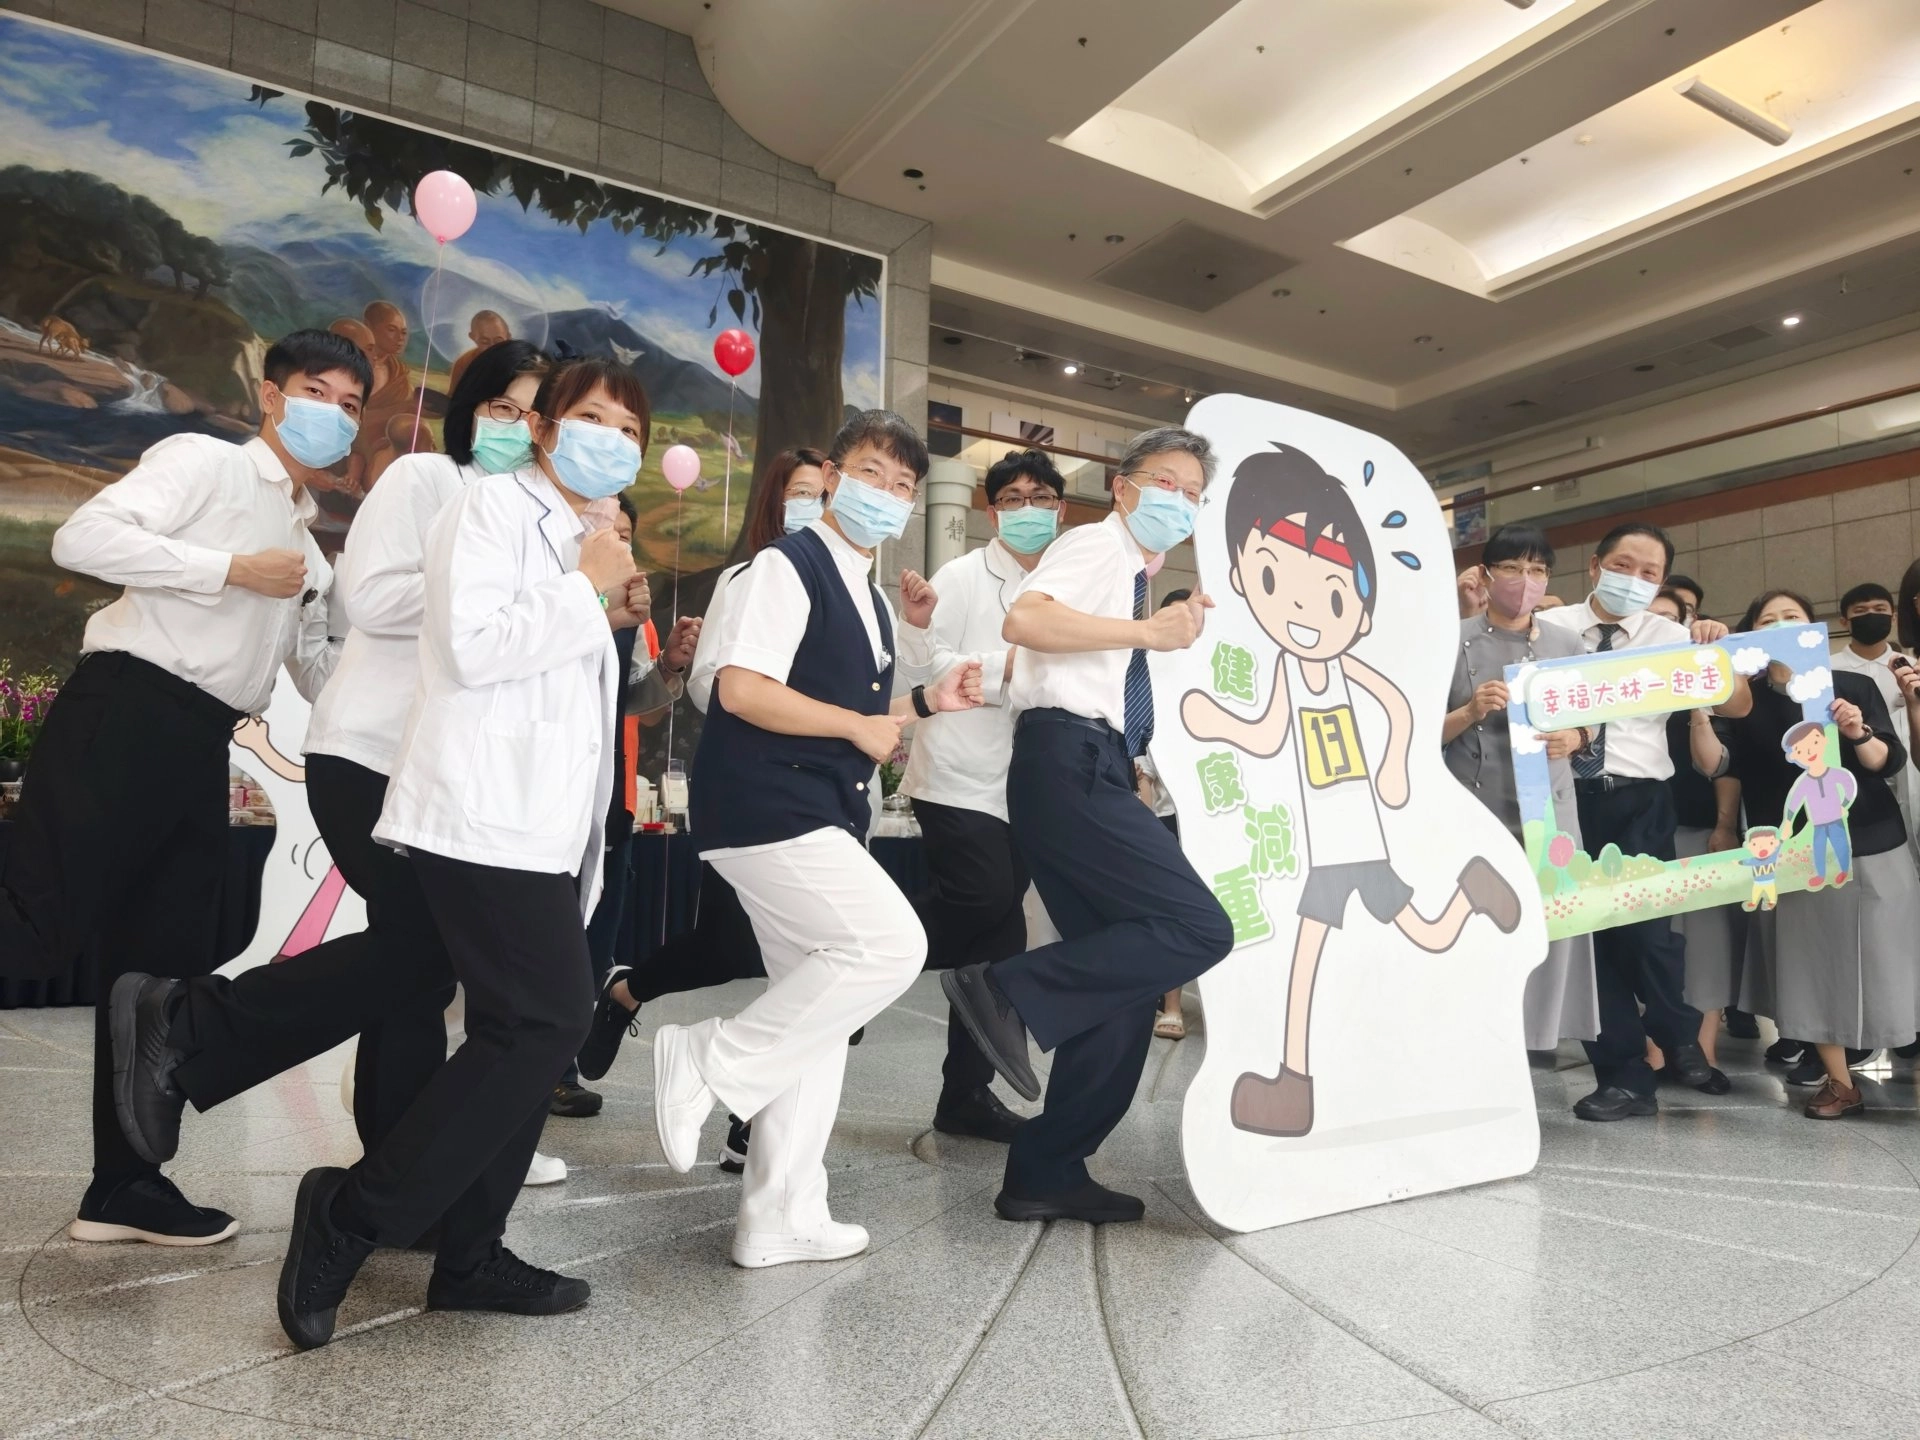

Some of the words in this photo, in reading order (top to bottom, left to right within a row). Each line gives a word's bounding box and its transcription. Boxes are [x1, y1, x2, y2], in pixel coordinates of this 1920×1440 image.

[1543, 666, 1719, 714] 幸福大林一起走
[1311, 714, 1351, 777] 13
[1196, 641, 1298, 944] 健康減重
